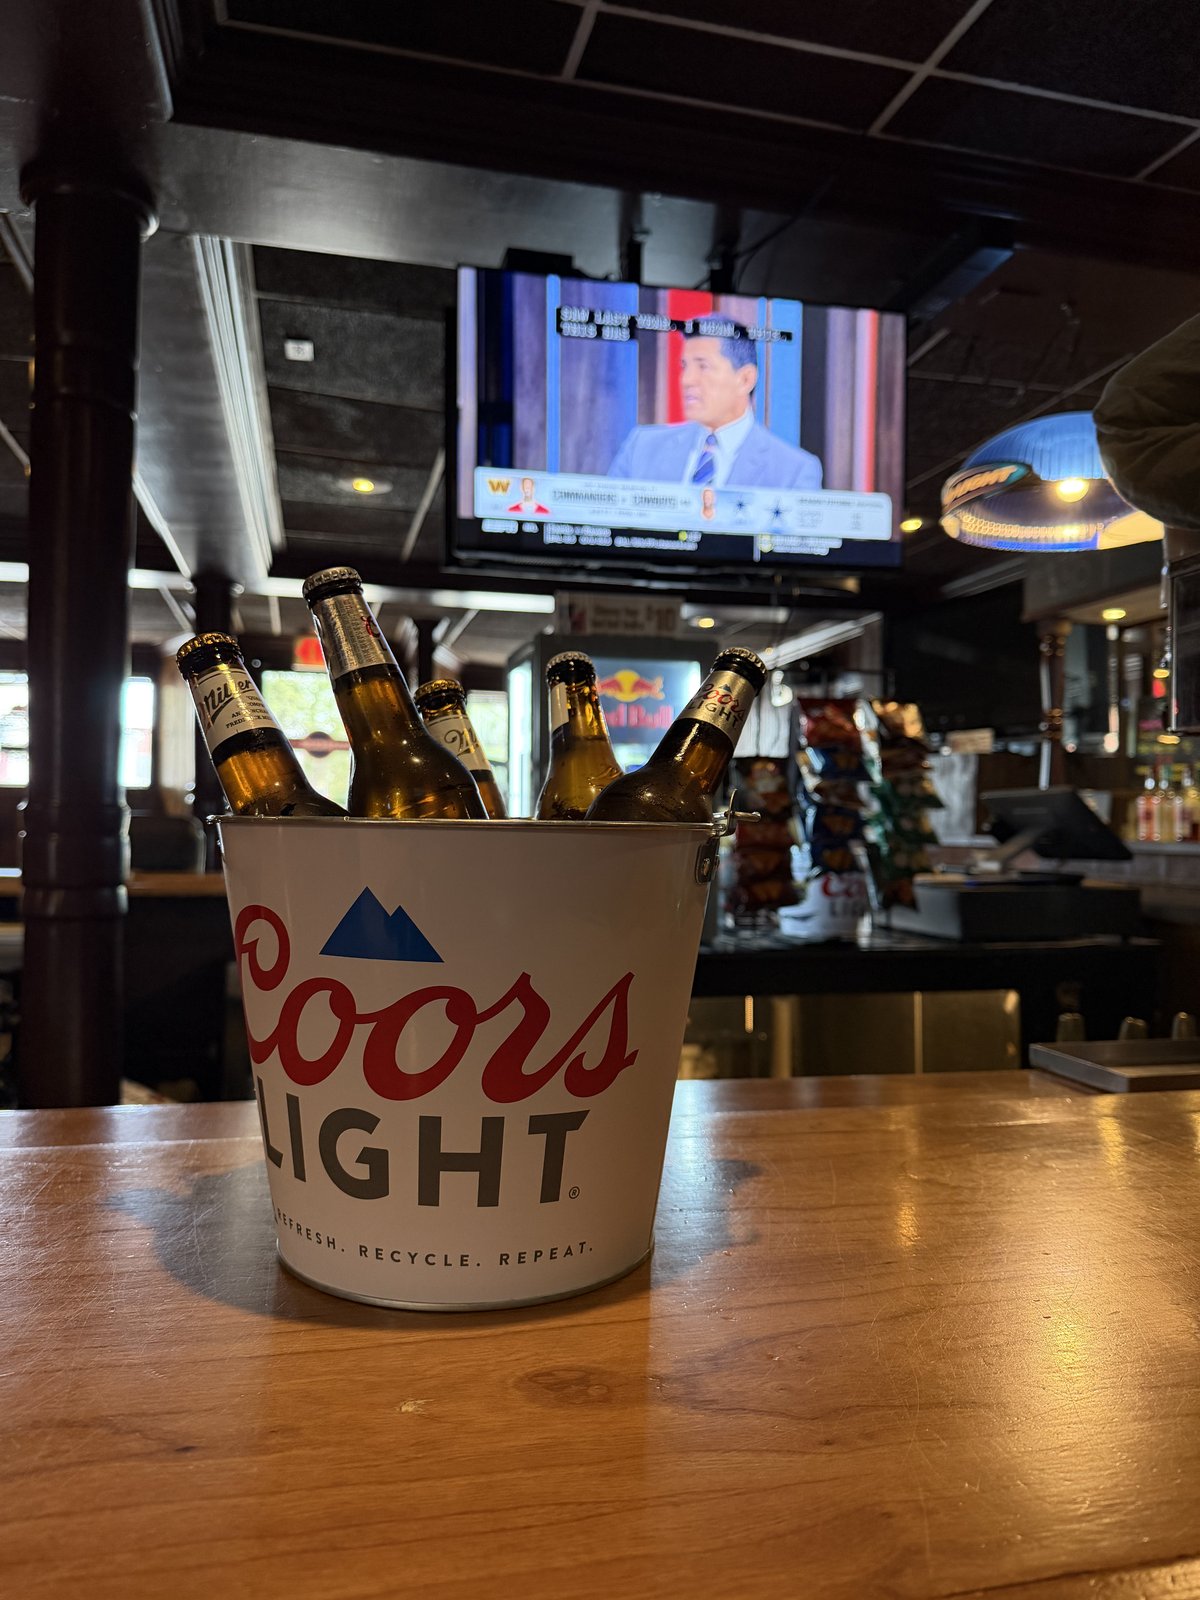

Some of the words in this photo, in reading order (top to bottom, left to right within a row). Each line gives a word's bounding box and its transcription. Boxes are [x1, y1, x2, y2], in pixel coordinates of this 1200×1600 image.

[203, 679, 253, 715] Miler
[629, 704, 672, 728] Bull
[688, 700, 742, 728] LIGHT
[235, 904, 640, 1104] Coors
[256, 1075, 591, 1208] LIGHT
[277, 1207, 346, 1253] REFRESH.
[358, 1244, 482, 1268] RECYCLE.
[499, 1241, 593, 1267] REPEAT.
